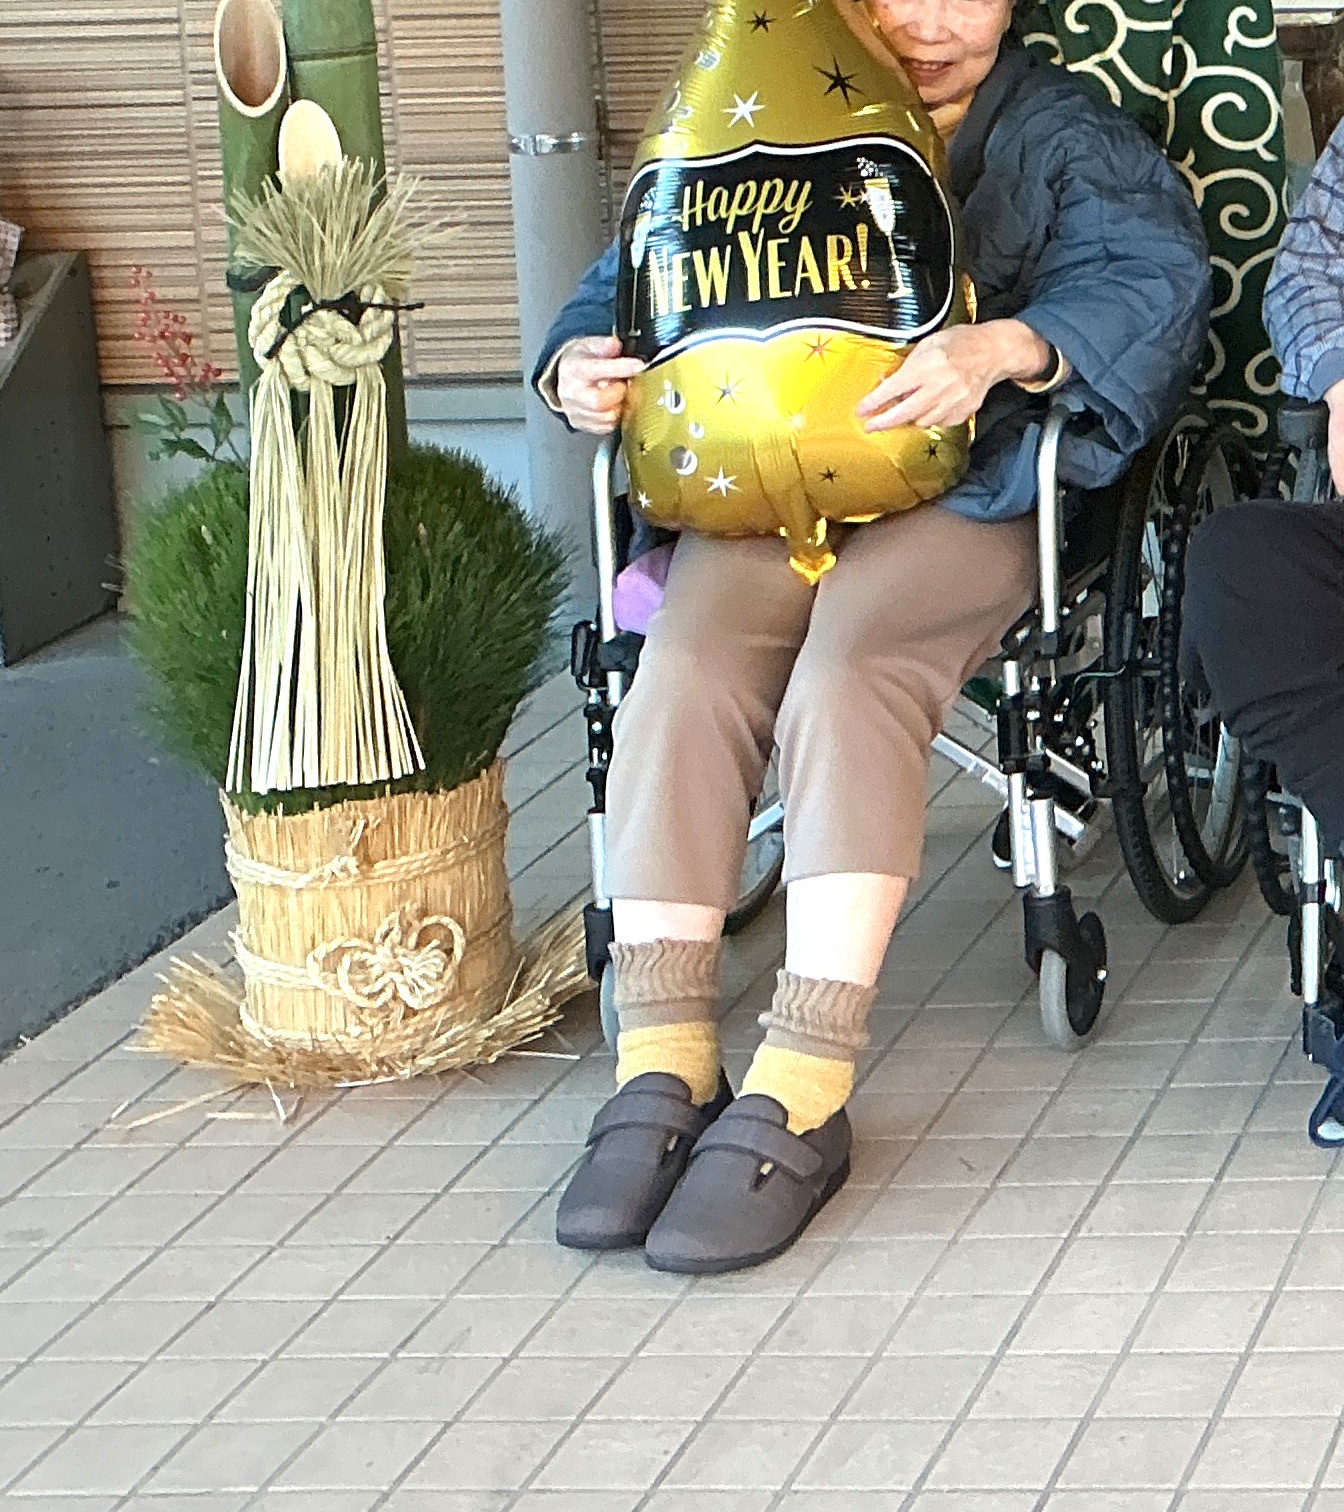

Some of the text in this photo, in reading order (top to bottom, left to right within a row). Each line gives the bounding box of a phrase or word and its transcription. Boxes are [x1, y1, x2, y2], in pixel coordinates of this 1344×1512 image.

[681, 177, 813, 235] Happy
[650, 222, 871, 318] NEW YEAR!
